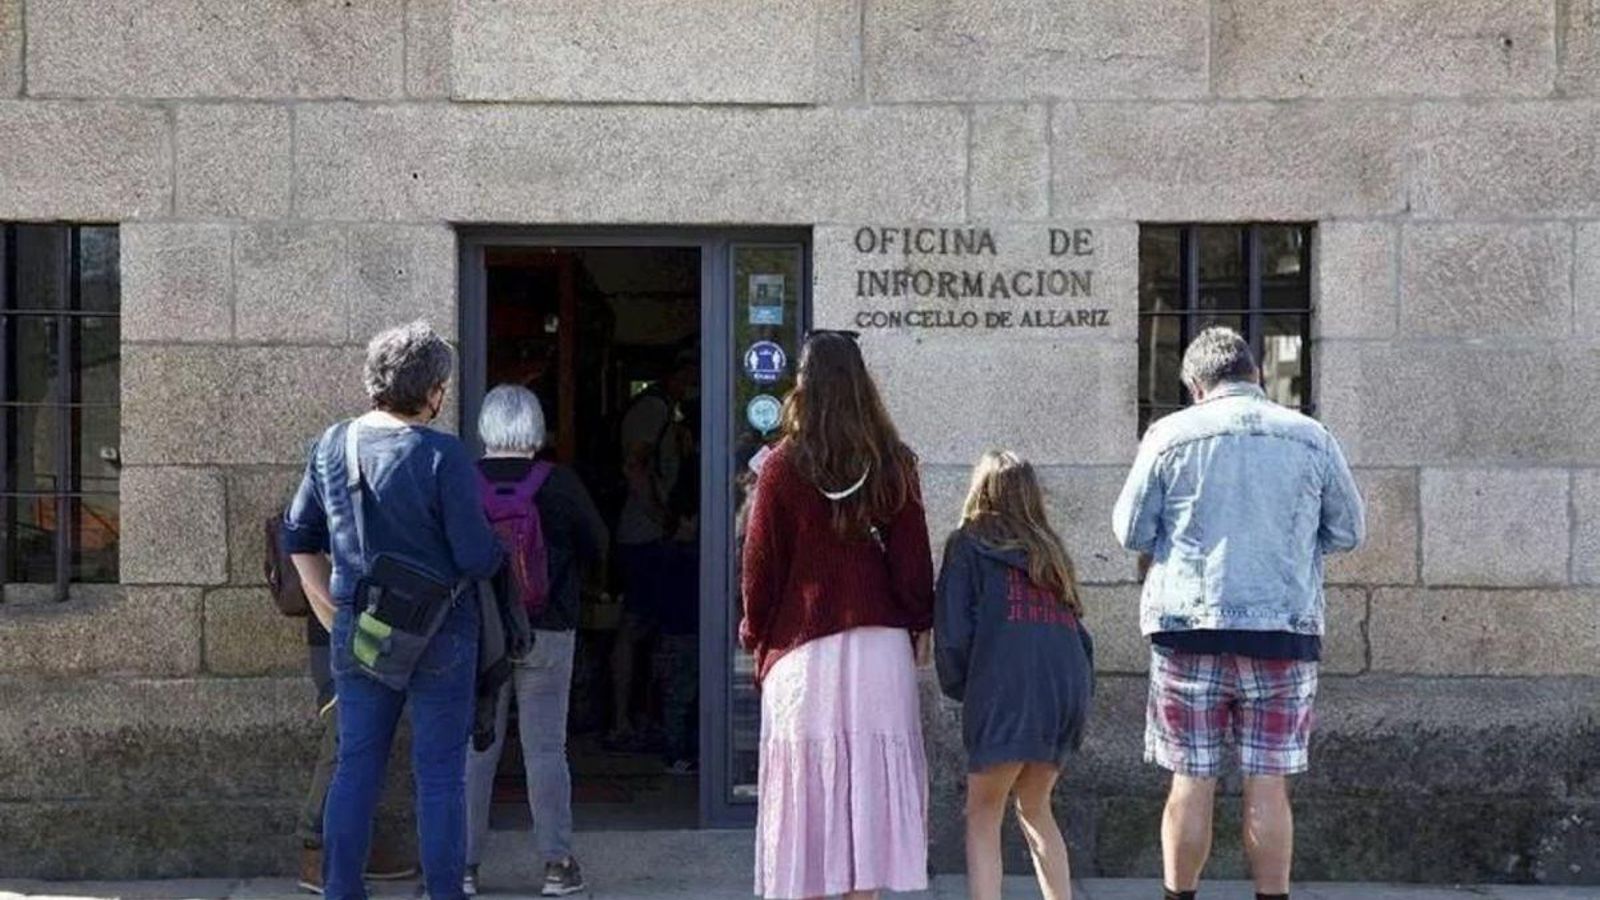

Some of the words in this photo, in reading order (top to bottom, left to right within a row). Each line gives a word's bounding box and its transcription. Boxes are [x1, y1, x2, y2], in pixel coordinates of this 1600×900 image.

[855, 226, 997, 256] OFICINA
[1048, 227, 1093, 256] DE
[856, 268, 1093, 300] INFORMACION
[855, 310, 978, 328] CONCELLO
[985, 311, 1013, 328] DE
[1019, 309, 1110, 328] ALLARIZ
